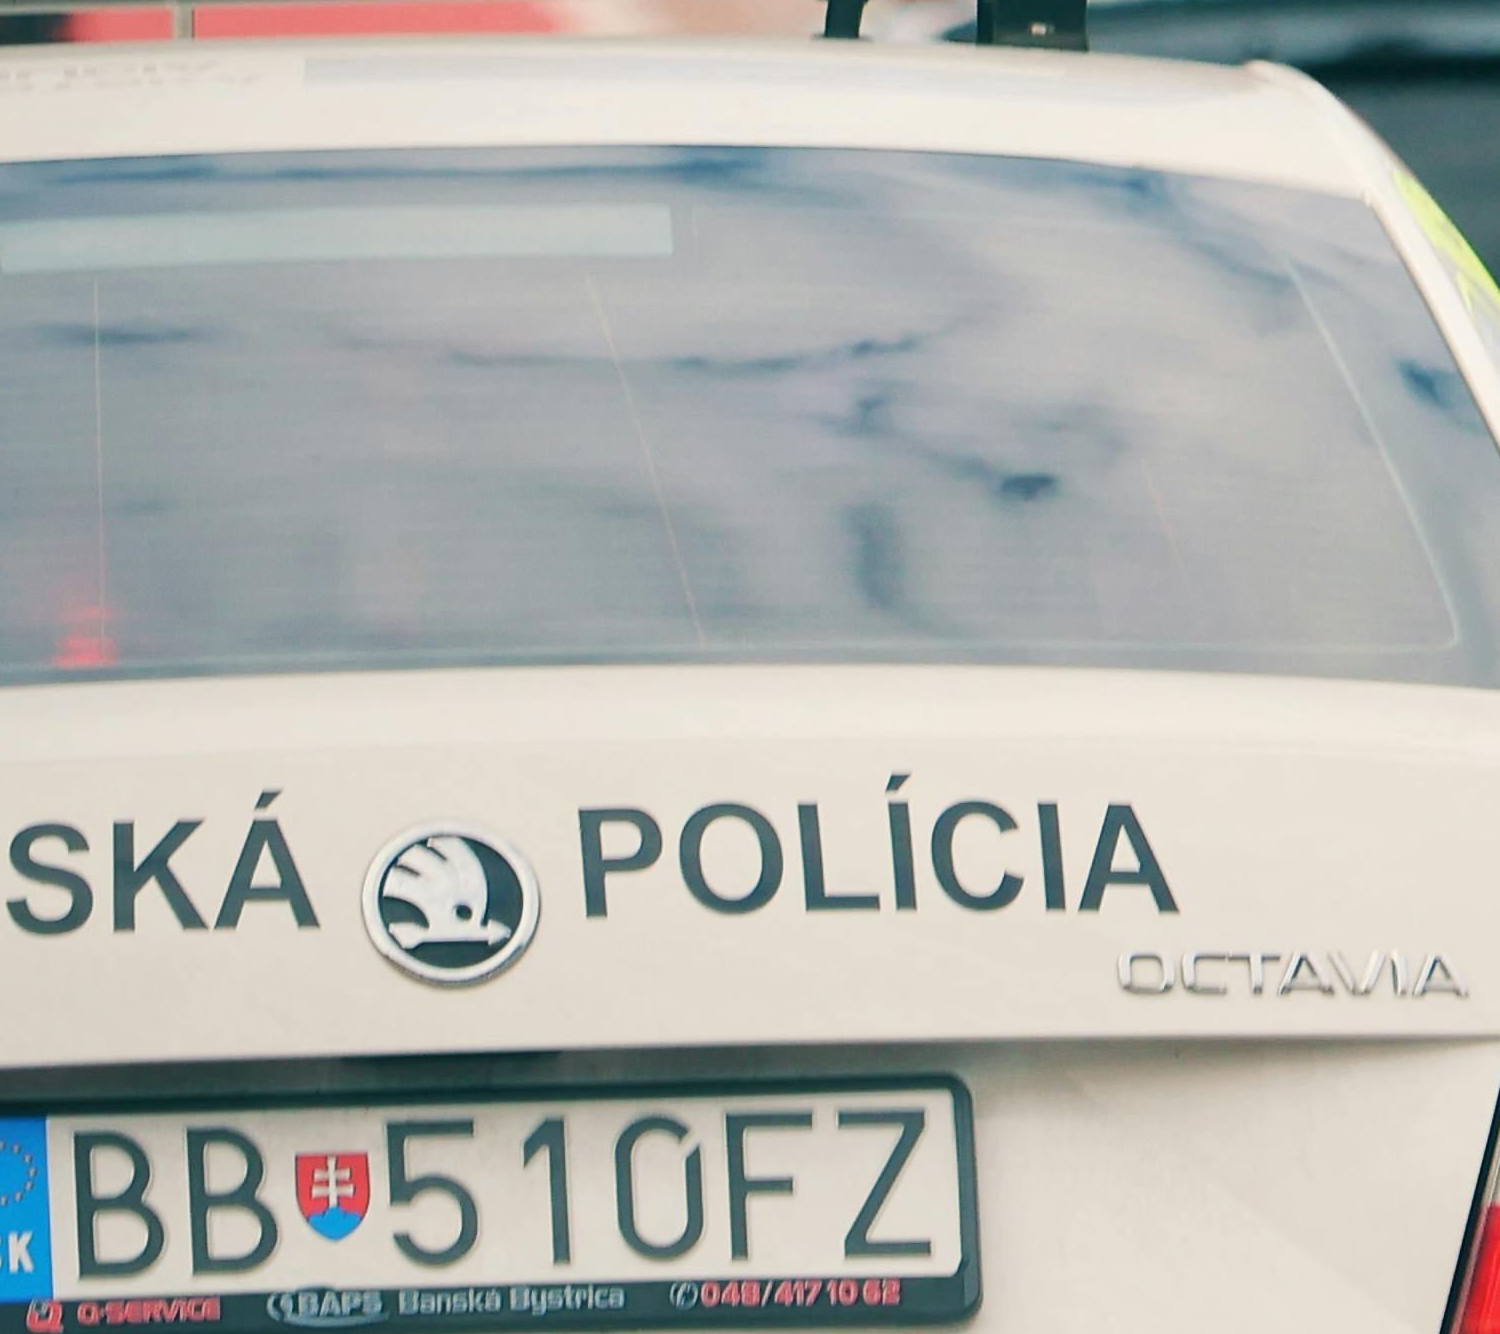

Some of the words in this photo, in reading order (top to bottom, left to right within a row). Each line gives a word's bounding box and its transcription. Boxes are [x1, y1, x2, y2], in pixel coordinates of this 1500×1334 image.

[576, 773, 1181, 919] POLÍCIA
[1114, 949, 1470, 999] OCTAVIA
[71, 1123, 280, 1280] BB
[385, 1106, 933, 1269] 510FZ
[508, 1282, 626, 1317] Bystrica
